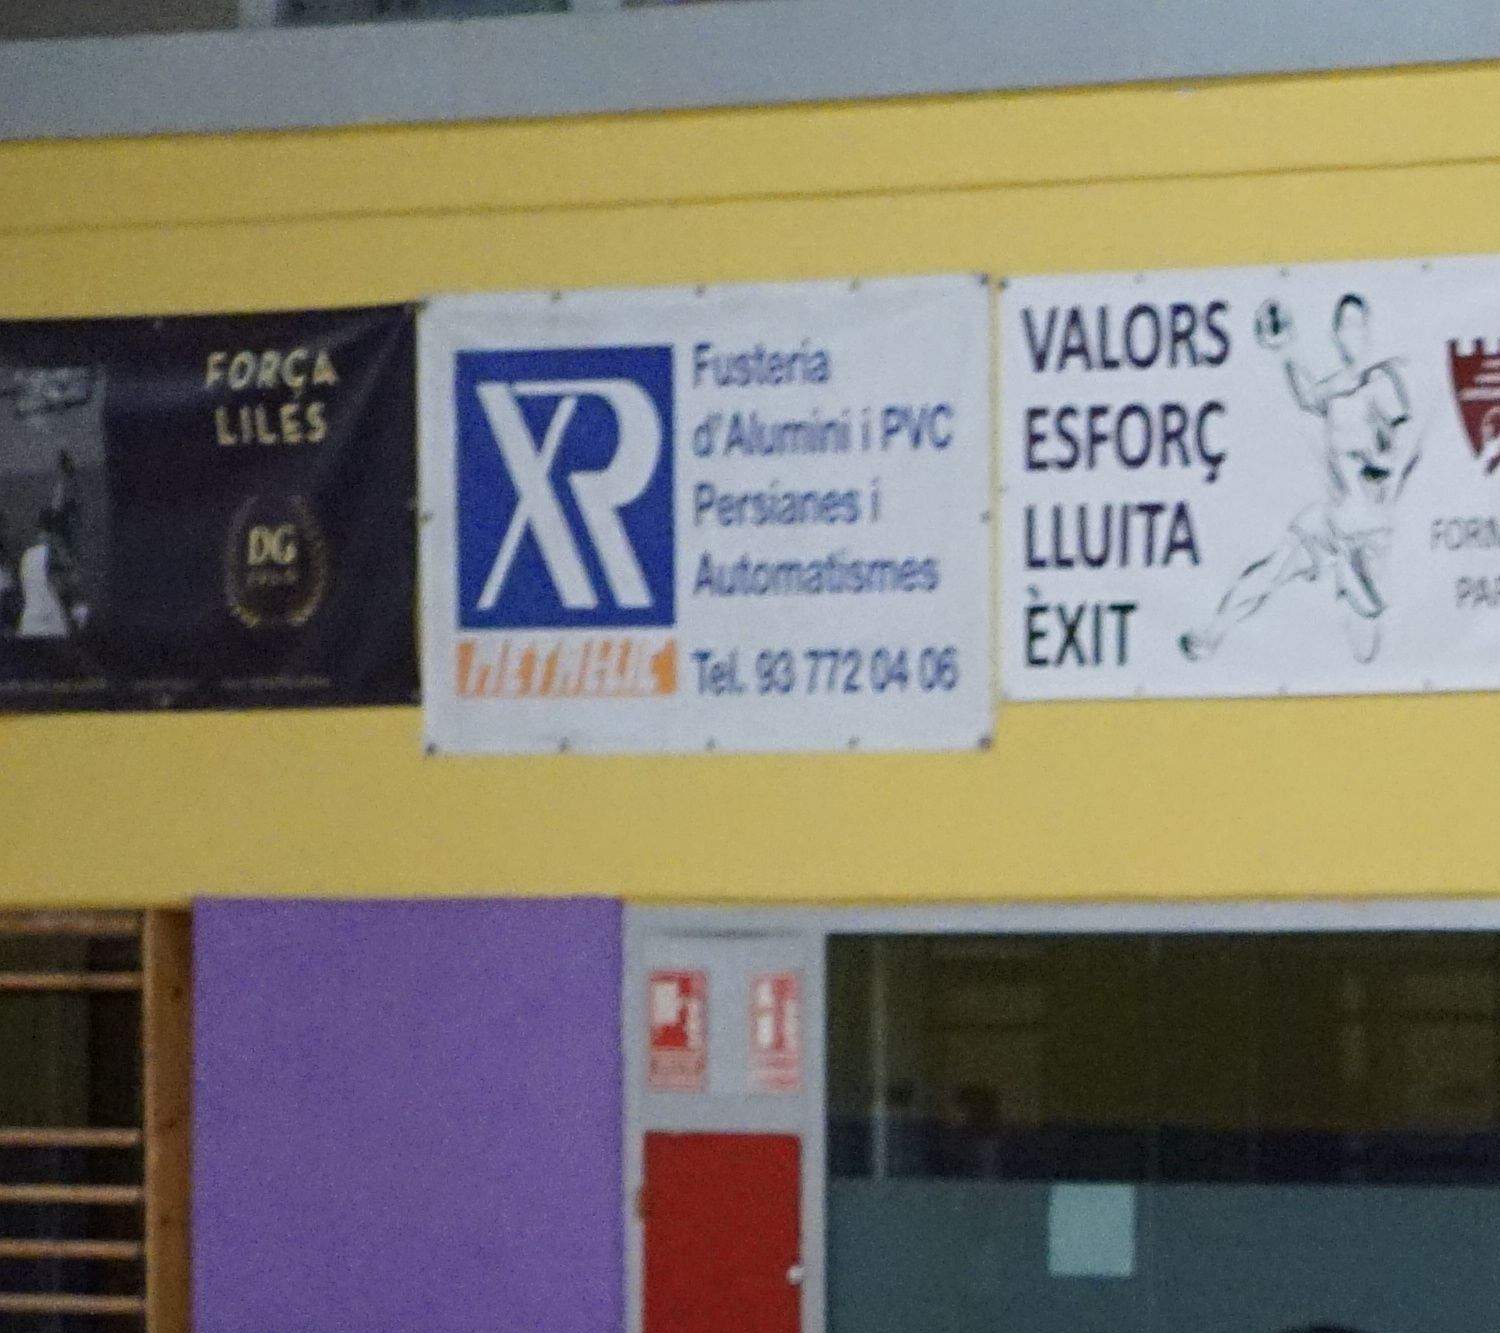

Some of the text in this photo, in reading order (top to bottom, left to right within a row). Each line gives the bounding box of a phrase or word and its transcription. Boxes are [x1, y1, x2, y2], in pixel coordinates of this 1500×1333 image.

[1021, 301, 1230, 371] VALORS
[204, 347, 340, 398] FORÇA
[692, 342, 830, 389] Fusteria
[214, 401, 328, 445] LILES
[694, 405, 955, 459] d'Alumini i PVC
[1024, 401, 1226, 483] ESFORÇ
[694, 478, 880, 525] Persianes i
[247, 523, 298, 566] DG
[1025, 502, 1200, 567] LLUITA
[694, 553, 939, 595] Automatismes
[1024, 587, 1137, 666] ÈXIT
[694, 652, 748, 697] Tel.
[759, 652, 797, 694] 93
[806, 650, 860, 692] 772
[870, 650, 912, 692] 04
[923, 647, 958, 689] 06
